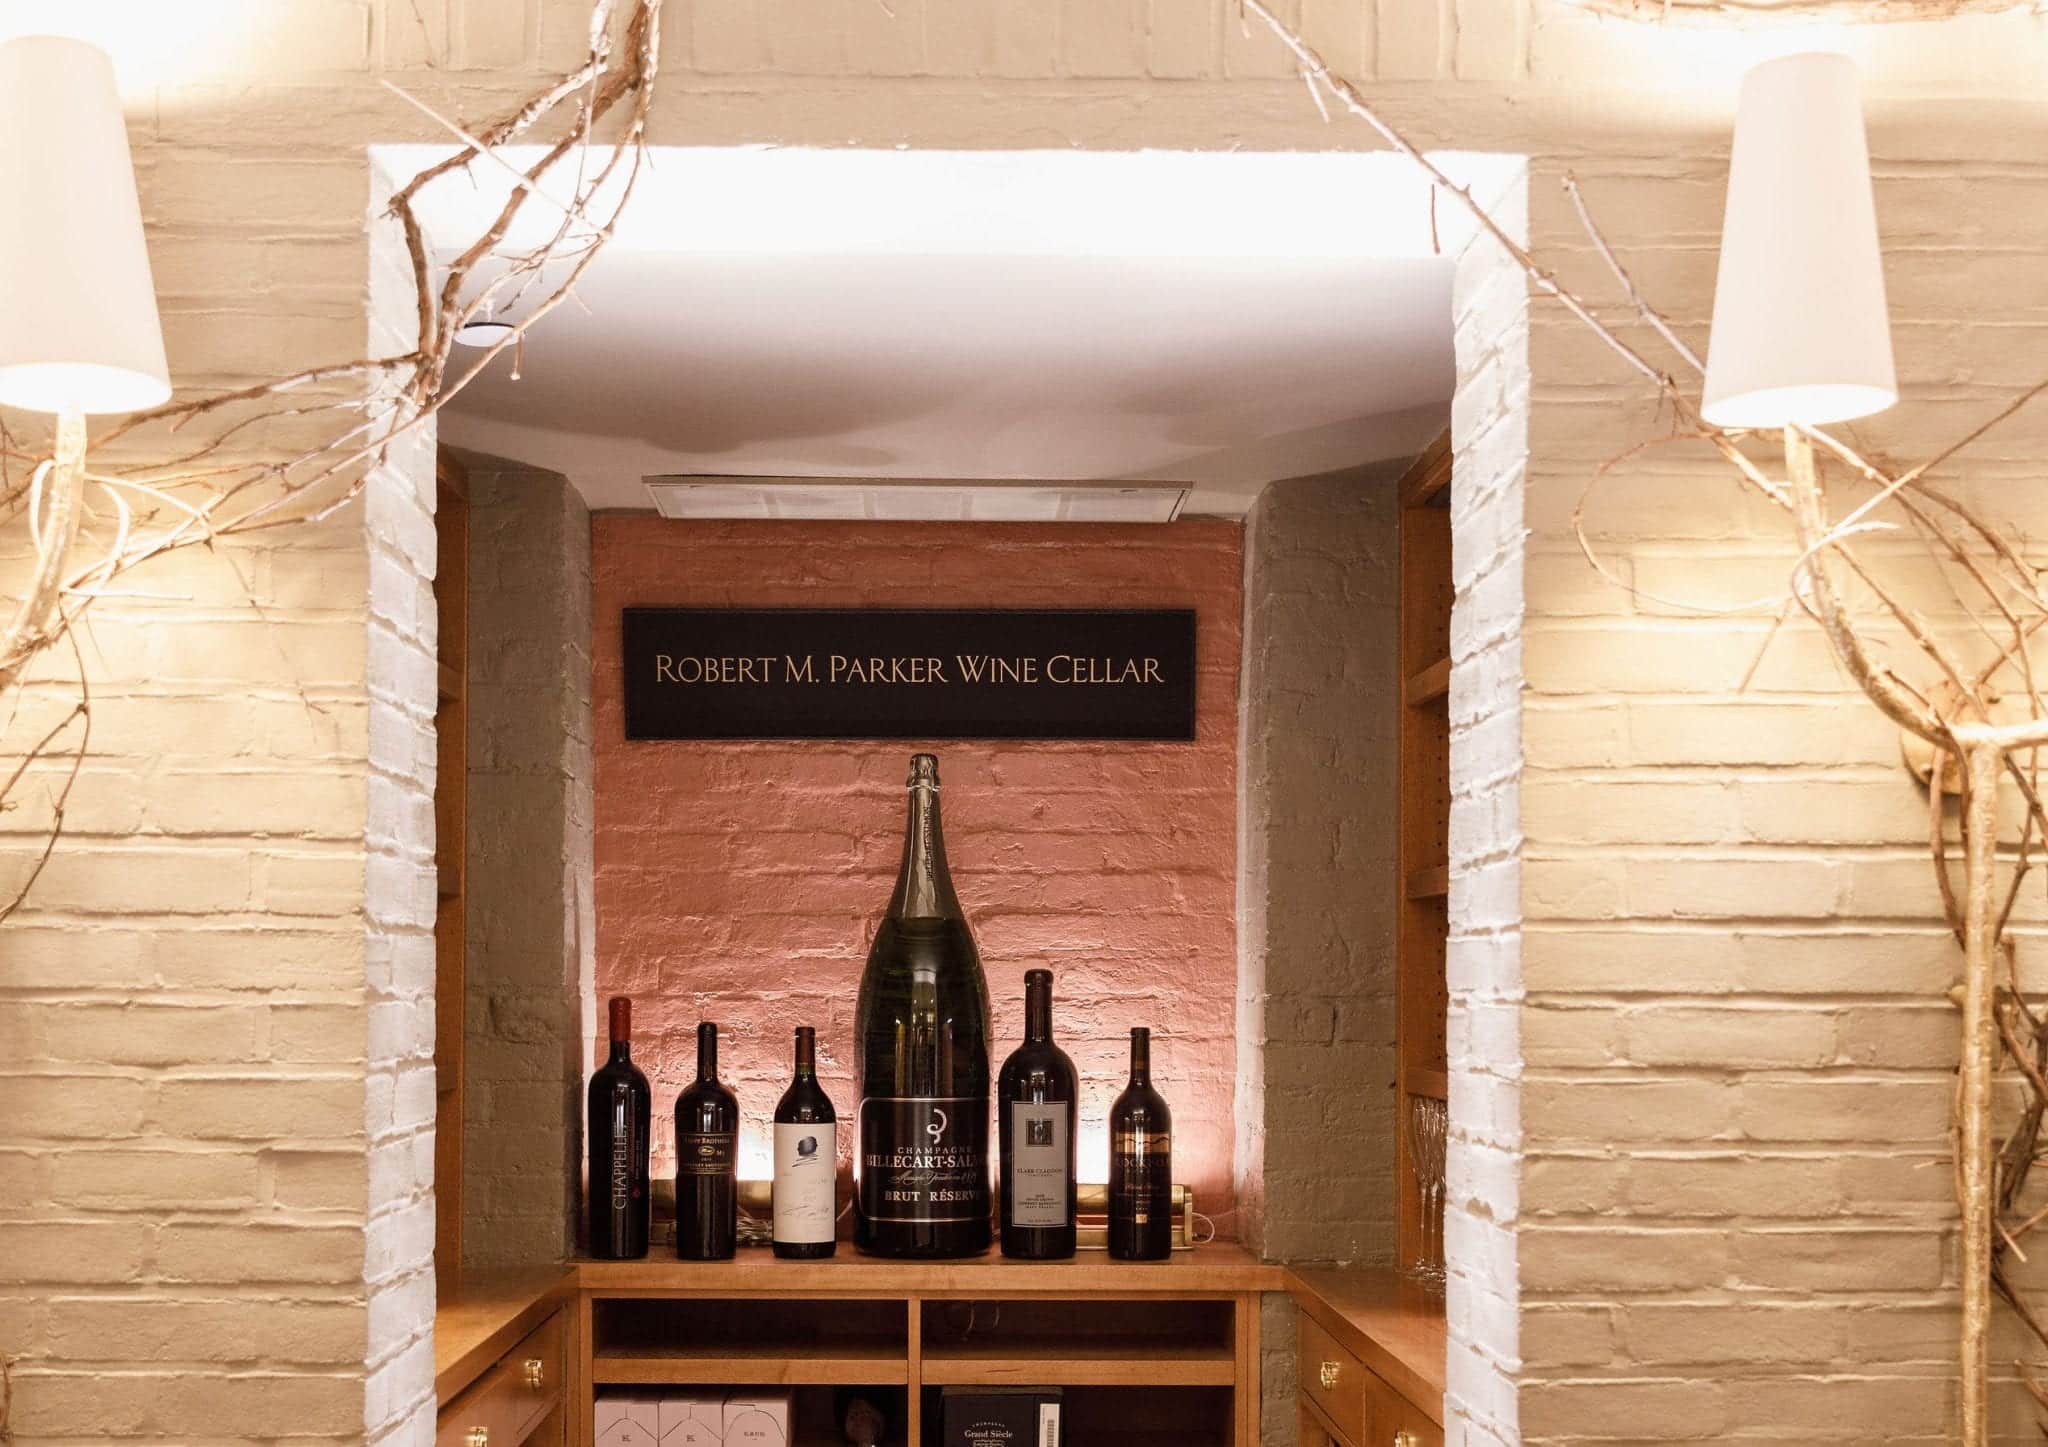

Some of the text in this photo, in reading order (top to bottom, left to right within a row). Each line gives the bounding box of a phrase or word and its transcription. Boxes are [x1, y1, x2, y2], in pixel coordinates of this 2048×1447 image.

[655, 655, 1165, 683] ROBERT M. PARKER WINE CELLAR
[884, 1191, 920, 1201] BRUT
[964, 1429, 1014, 1438] Grand Siècle
